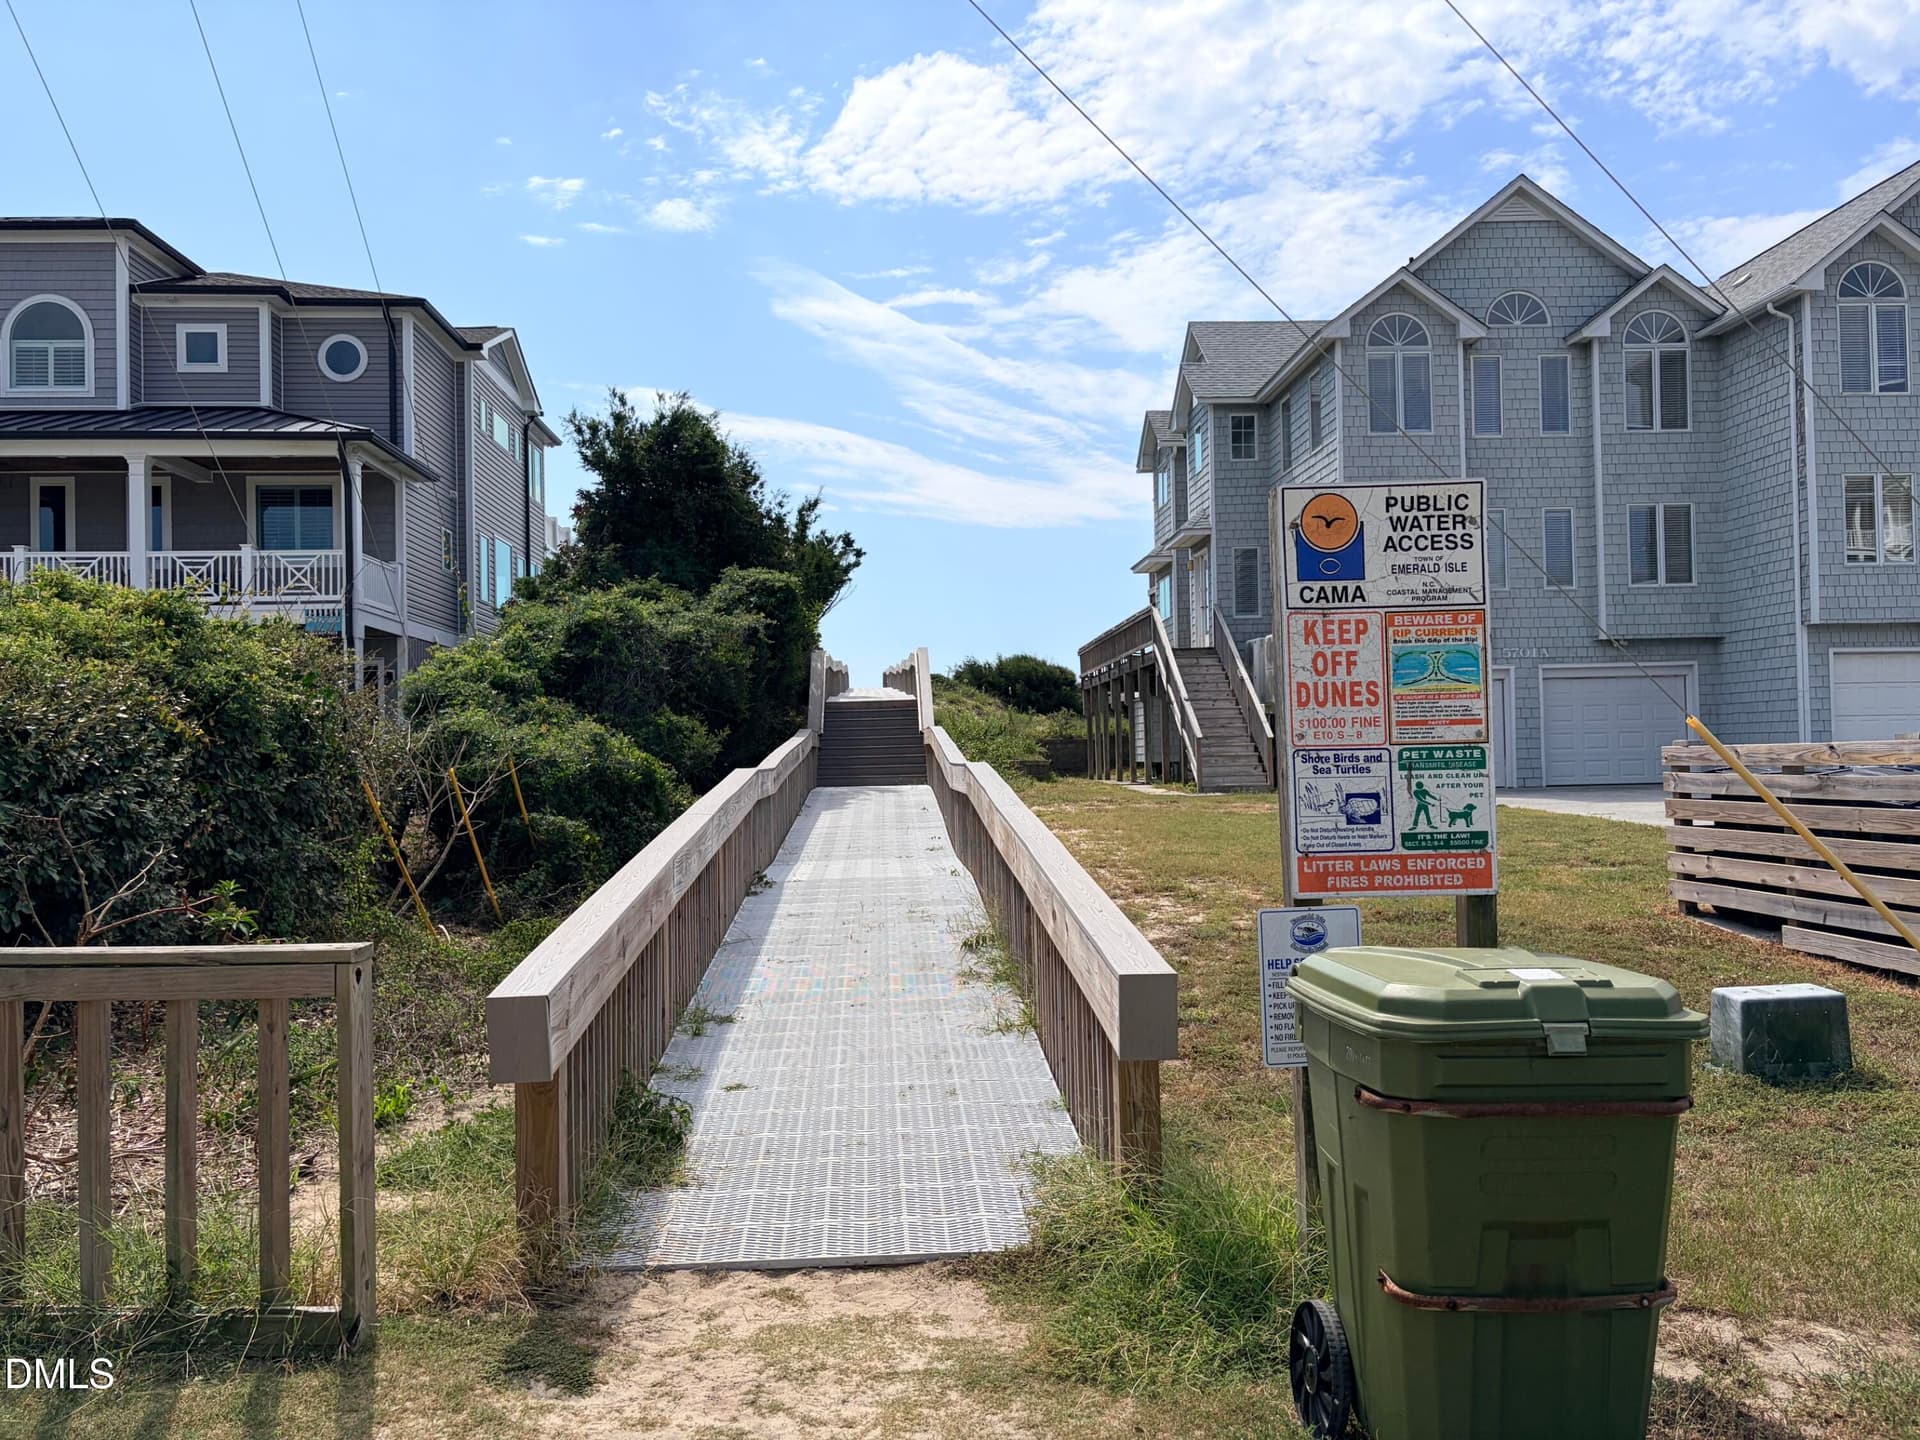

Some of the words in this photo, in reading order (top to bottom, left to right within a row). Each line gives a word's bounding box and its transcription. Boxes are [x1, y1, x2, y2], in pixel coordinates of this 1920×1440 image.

[1385, 494, 1469, 513] PUBLIC
[1389, 514, 1467, 532] WATER
[1383, 533, 1474, 552] ACCESS
[1391, 563, 1440, 574] EMERALD
[1445, 562, 1468, 573] ISLE
[1300, 585, 1367, 604] CAMA
[1422, 587, 1472, 595] MANAGEMENT
[1393, 614, 1453, 626] BEWARE
[1458, 613, 1476, 624] OF
[1303, 618, 1368, 645] KEEP
[1392, 628, 1411, 638] RIP
[1415, 627, 1478, 637] CURRENTS
[1311, 650, 1358, 677] OFF
[1296, 680, 1380, 708] DUNES
[1298, 717, 1346, 729] $100.00
[1351, 716, 1381, 728] FINE
[1301, 753, 1331, 764] Shore
[1333, 753, 1360, 763] Birds
[1363, 752, 1382, 763] and
[1402, 750, 1429, 759] PET
[1433, 749, 1481, 759] WASTE
[1312, 764, 1332, 775] Sea
[1334, 764, 1371, 775] Turtles
[1303, 859, 1354, 873] LITTER
[1360, 858, 1400, 872] LAWS
[1407, 857, 1486, 870] ENFORCED
[1327, 875, 1369, 888] FIRES
[1374, 873, 1463, 887] PROHIBITED
[1267, 959, 1291, 970] HELP
[1272, 981, 1284, 989] FILL
[1273, 1002, 1287, 1010] PICK
[1275, 1023, 1283, 1031] NO
[1275, 1033, 1284, 1041] NO
